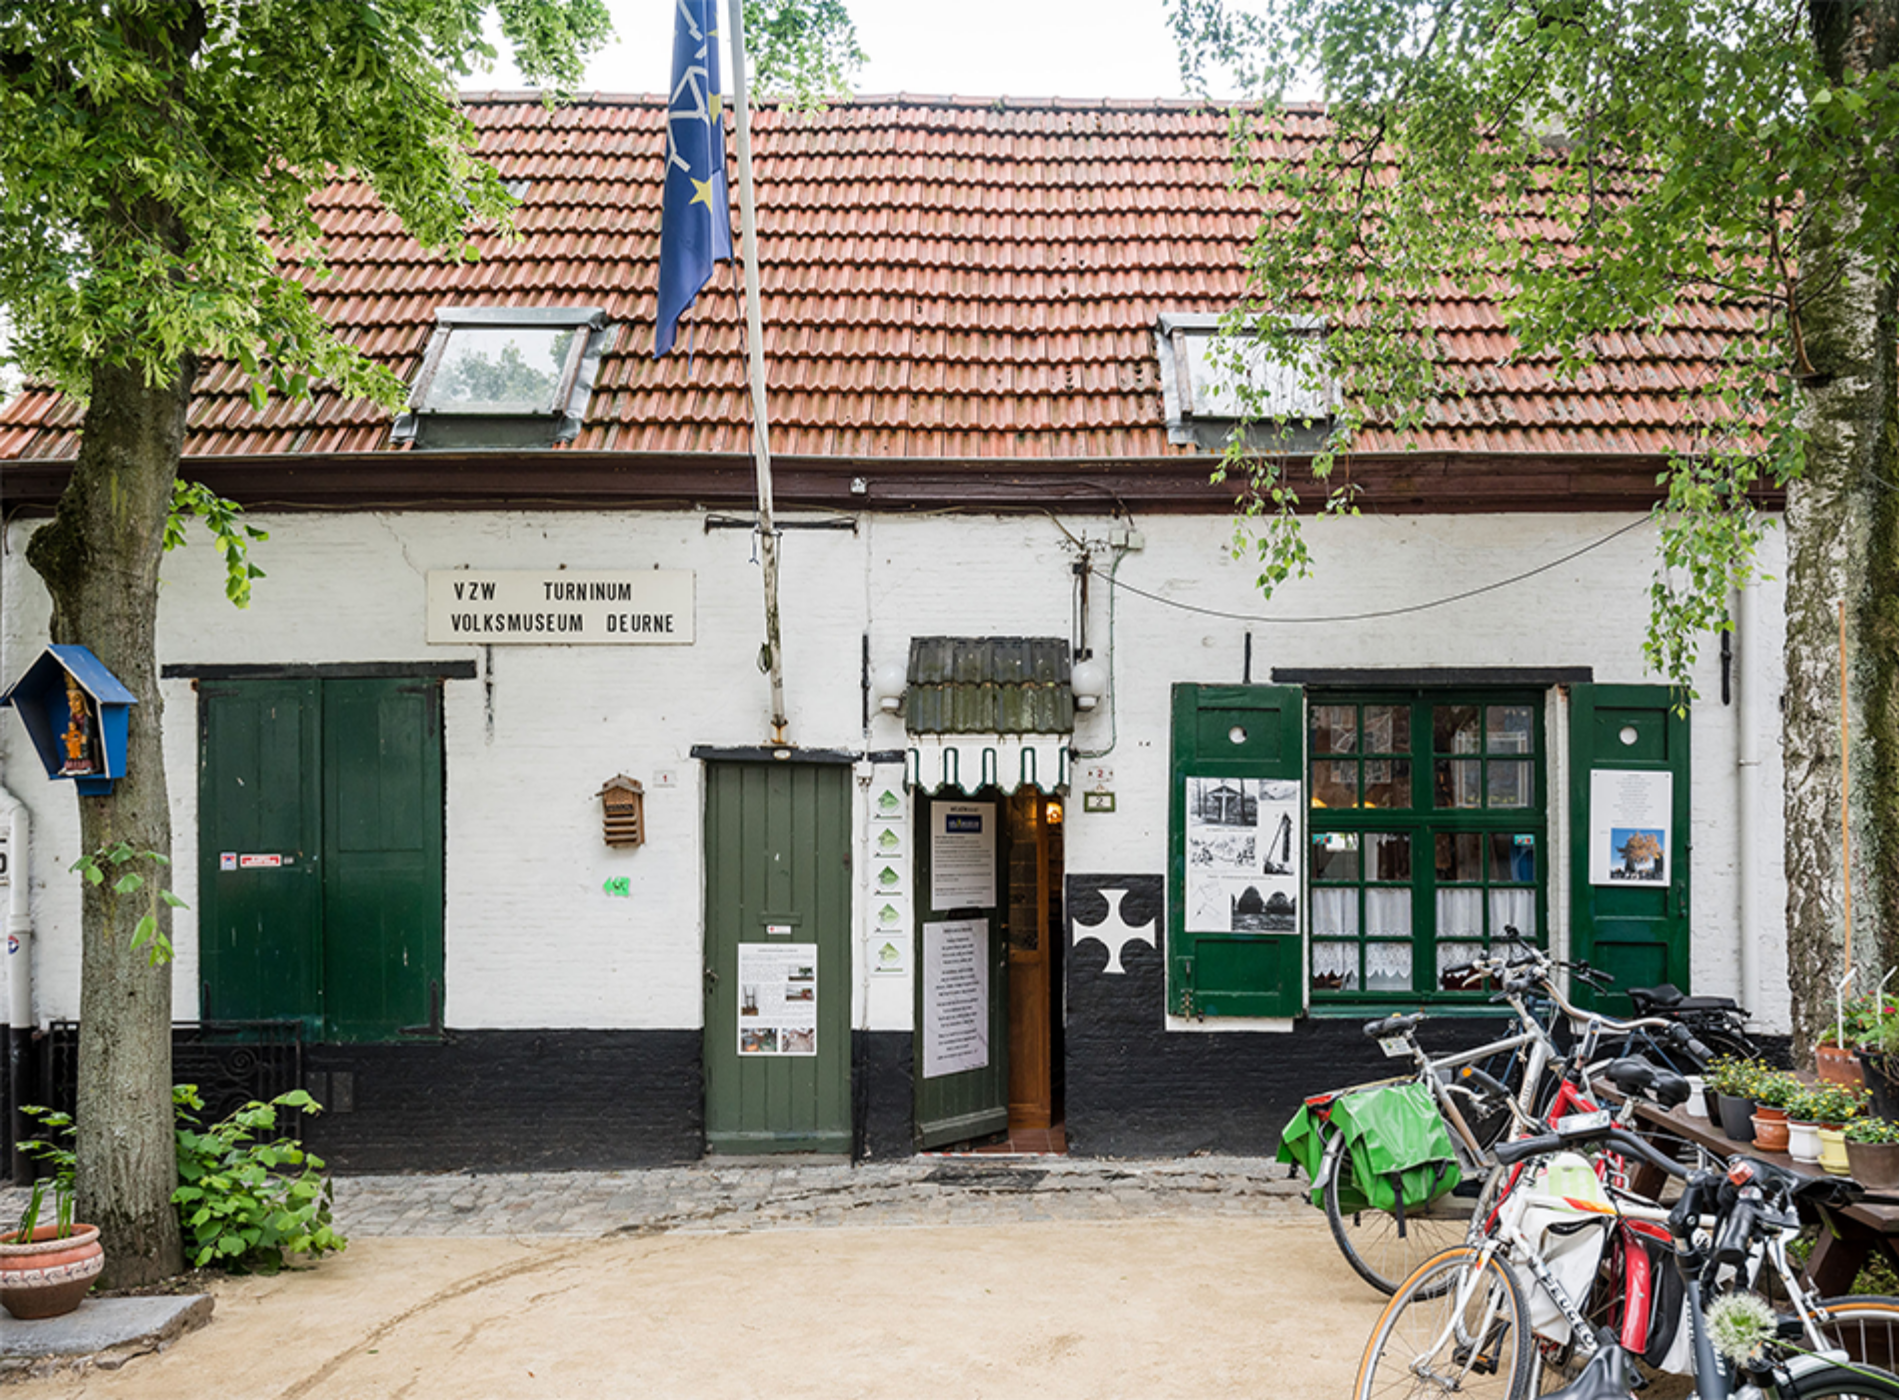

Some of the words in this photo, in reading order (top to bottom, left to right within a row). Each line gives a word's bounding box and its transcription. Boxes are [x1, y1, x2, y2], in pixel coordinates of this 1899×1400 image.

[454, 582, 495, 600] VZW
[544, 582, 631, 601] TURNINUM
[451, 613, 583, 632] VOLKSMUSEUM
[607, 614, 673, 632] DEURNE
[1097, 769, 1104, 778] 2
[1096, 797, 1104, 807] 2
[1541, 1275, 1596, 1345] PEUGEO
